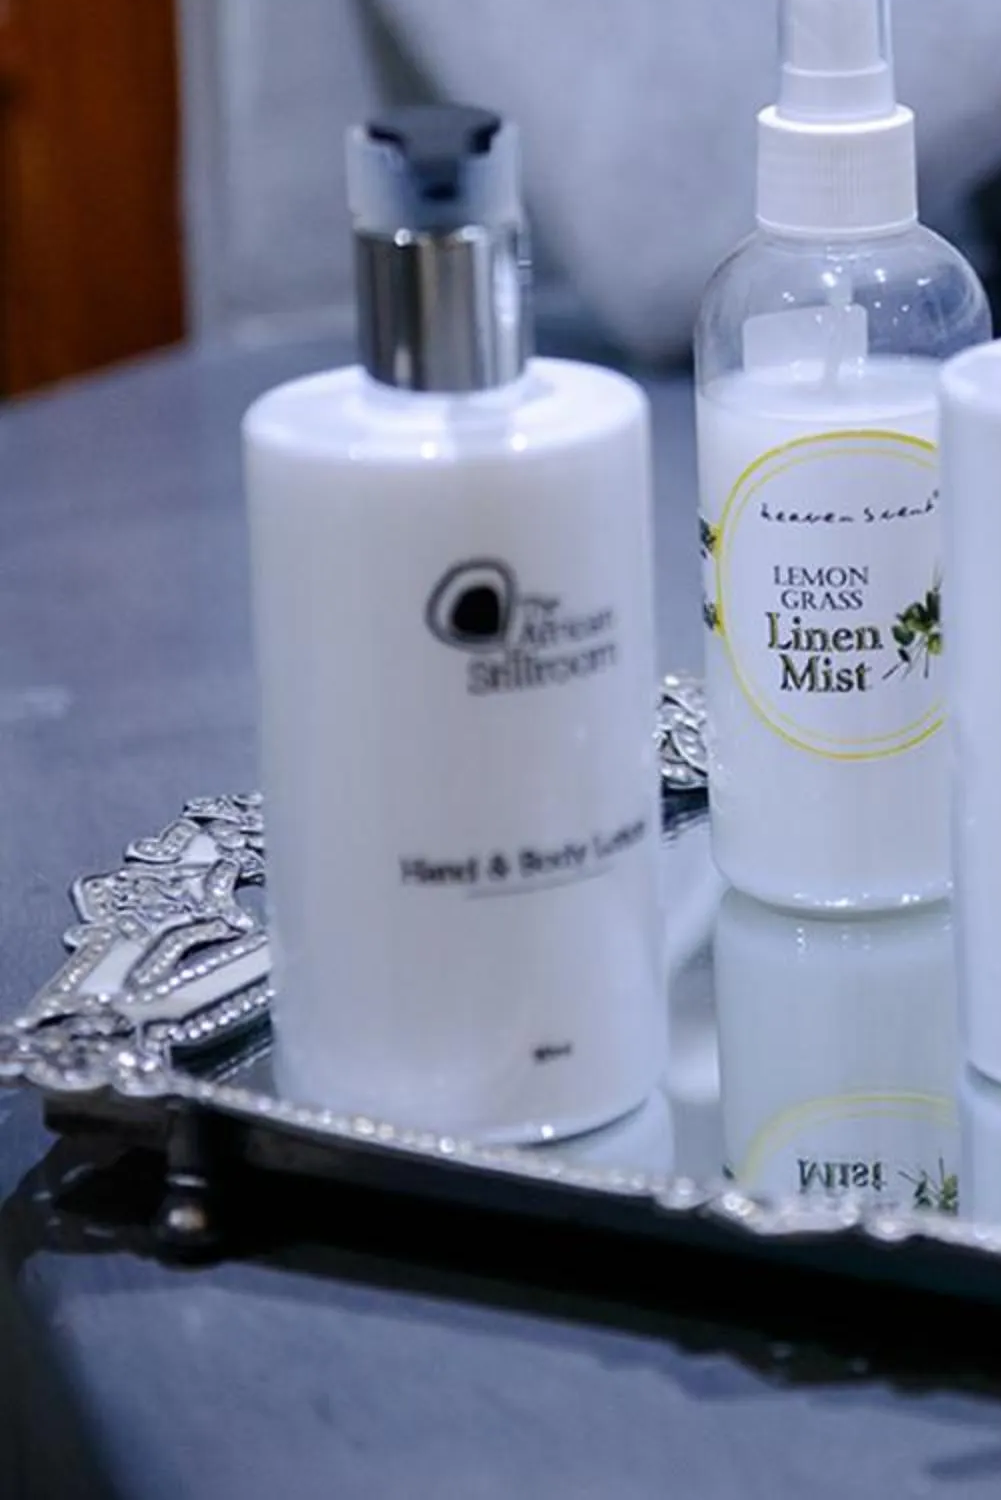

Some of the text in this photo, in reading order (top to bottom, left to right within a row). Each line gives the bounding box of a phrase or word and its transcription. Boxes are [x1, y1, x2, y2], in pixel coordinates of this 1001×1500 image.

[773, 566, 869, 586] LEMON
[780, 590, 863, 610] GRASS
[765, 612, 884, 650] Linen
[779, 654, 873, 693] Mist
[399, 855, 479, 885] Hand
[487, 850, 511, 881] &
[518, 843, 589, 880] Body
